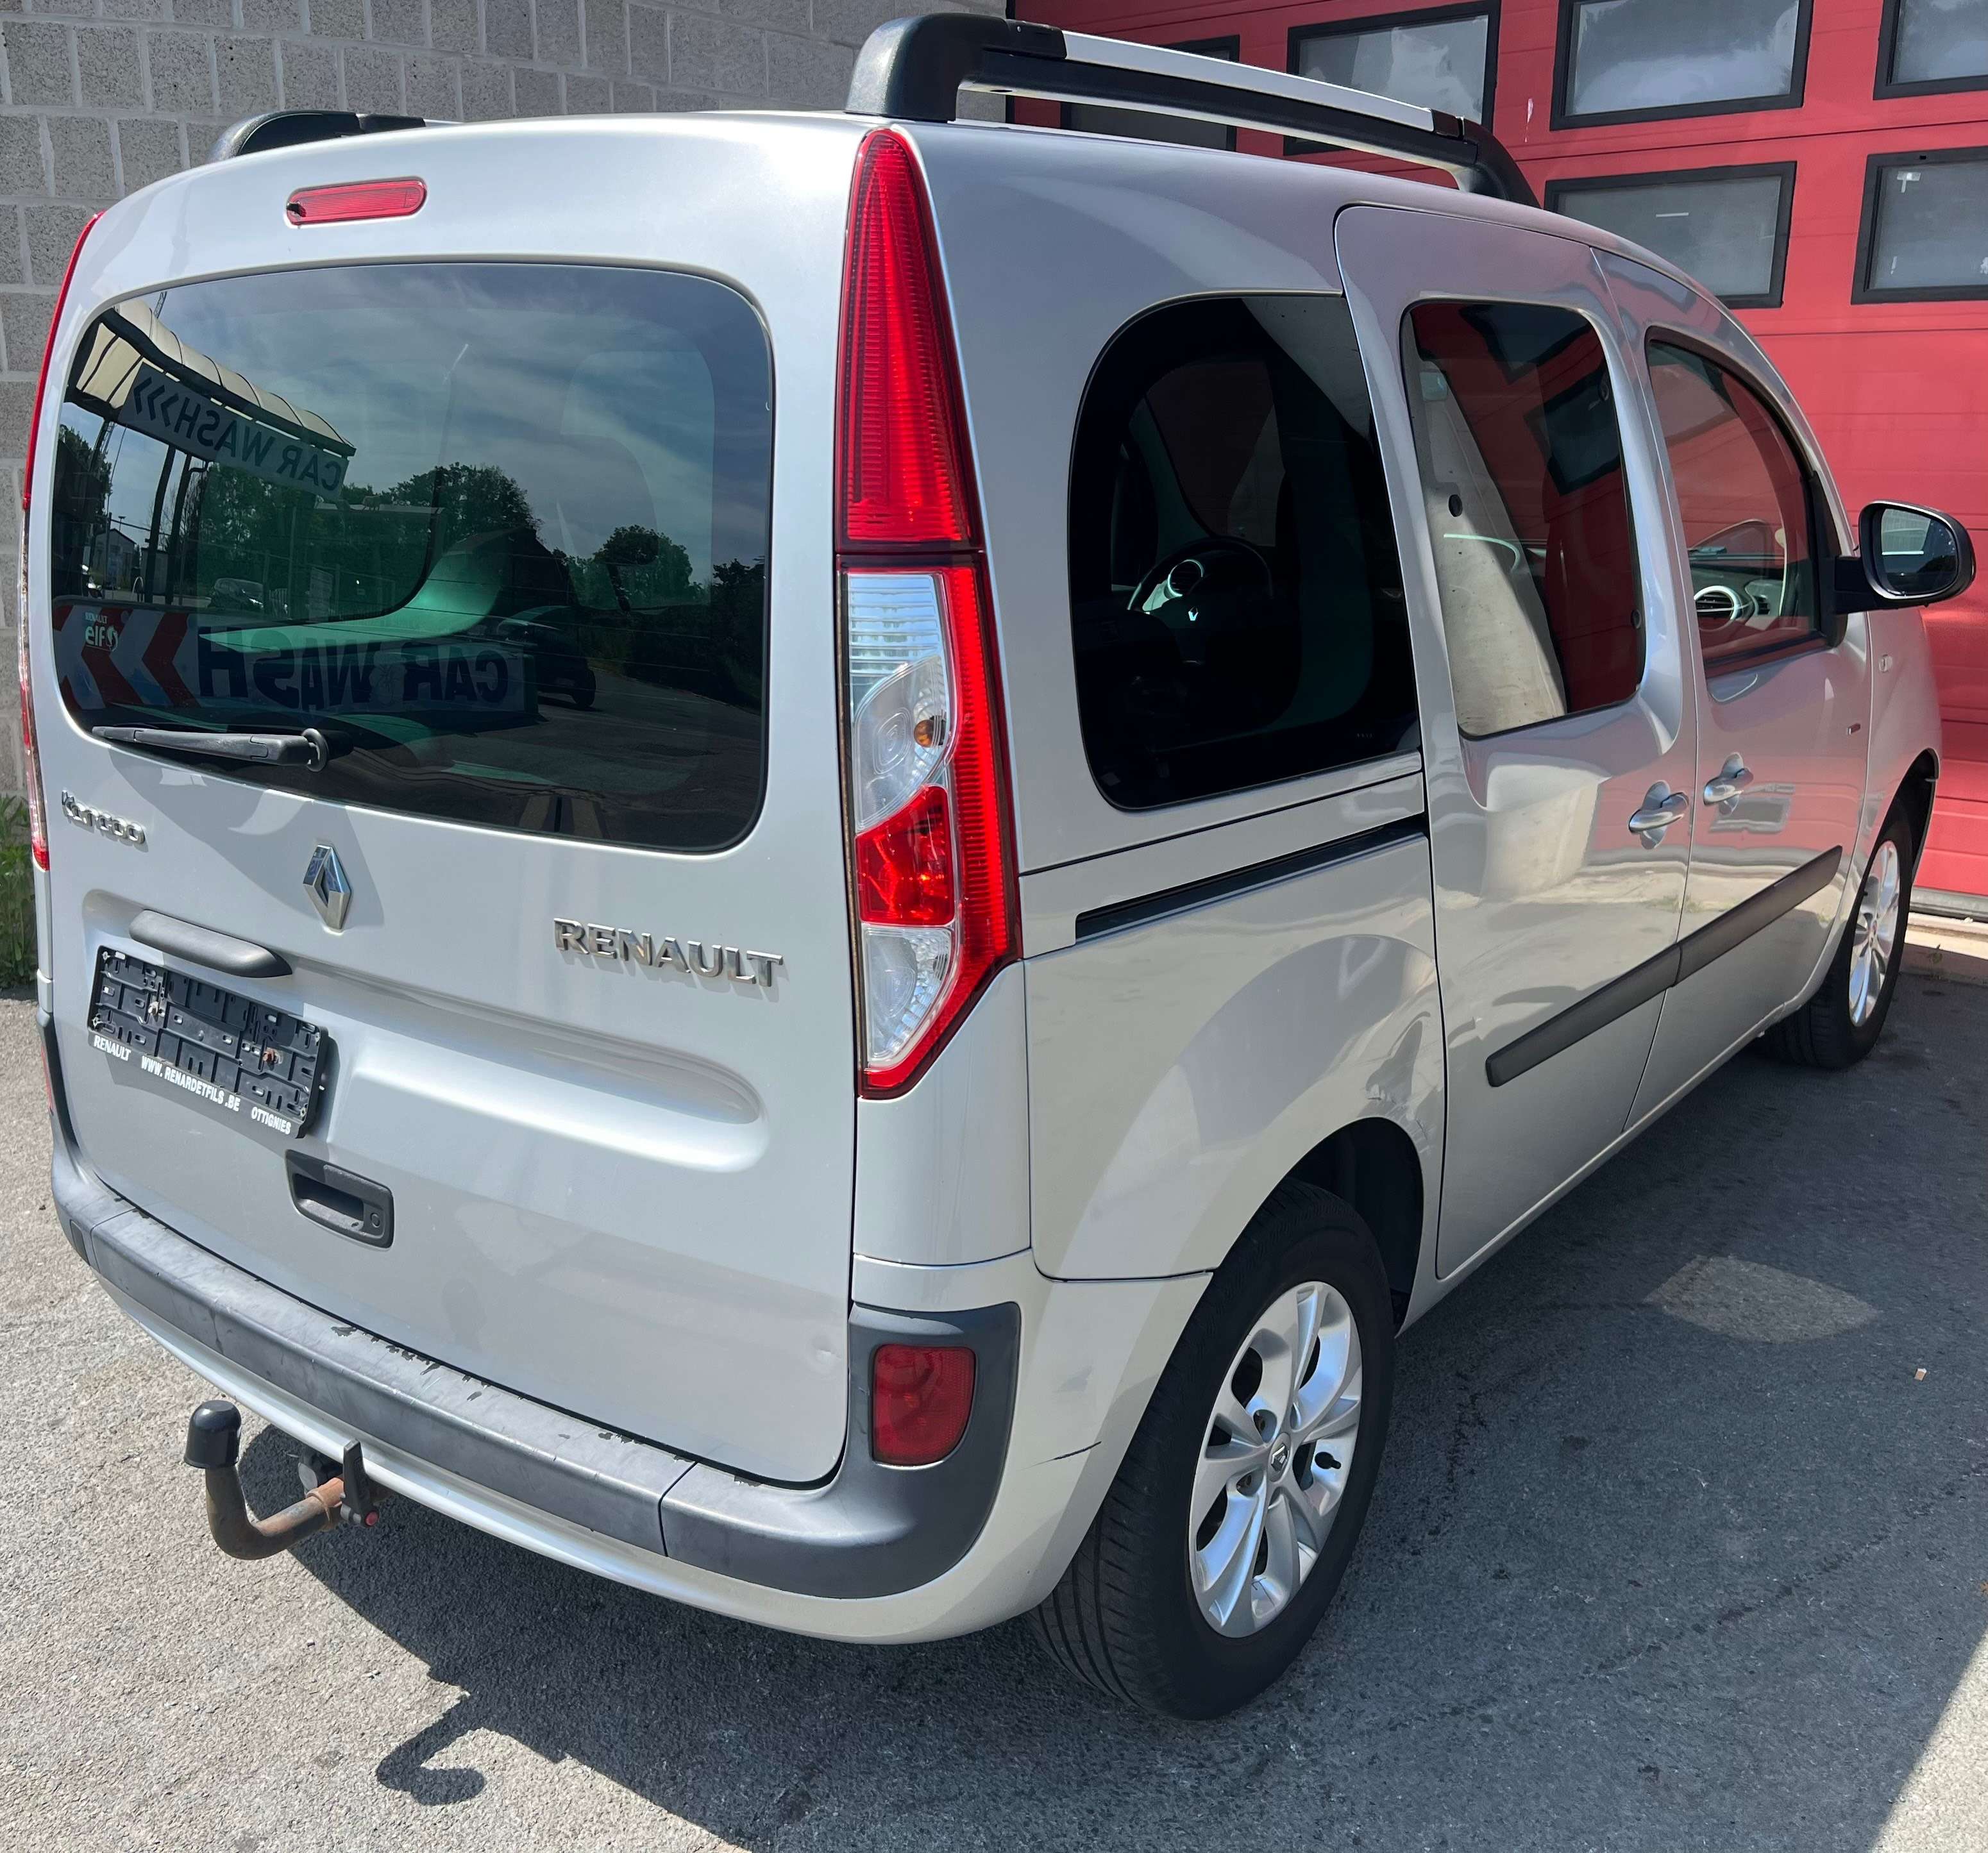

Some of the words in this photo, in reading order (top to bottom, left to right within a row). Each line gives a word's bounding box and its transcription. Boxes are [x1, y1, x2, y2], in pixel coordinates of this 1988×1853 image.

[85, 625, 106, 647] elf
[553, 918, 784, 987] RENAULT
[94, 1035, 131, 1061] RENAULT
[251, 1106, 292, 1135] OTTIGNIES
